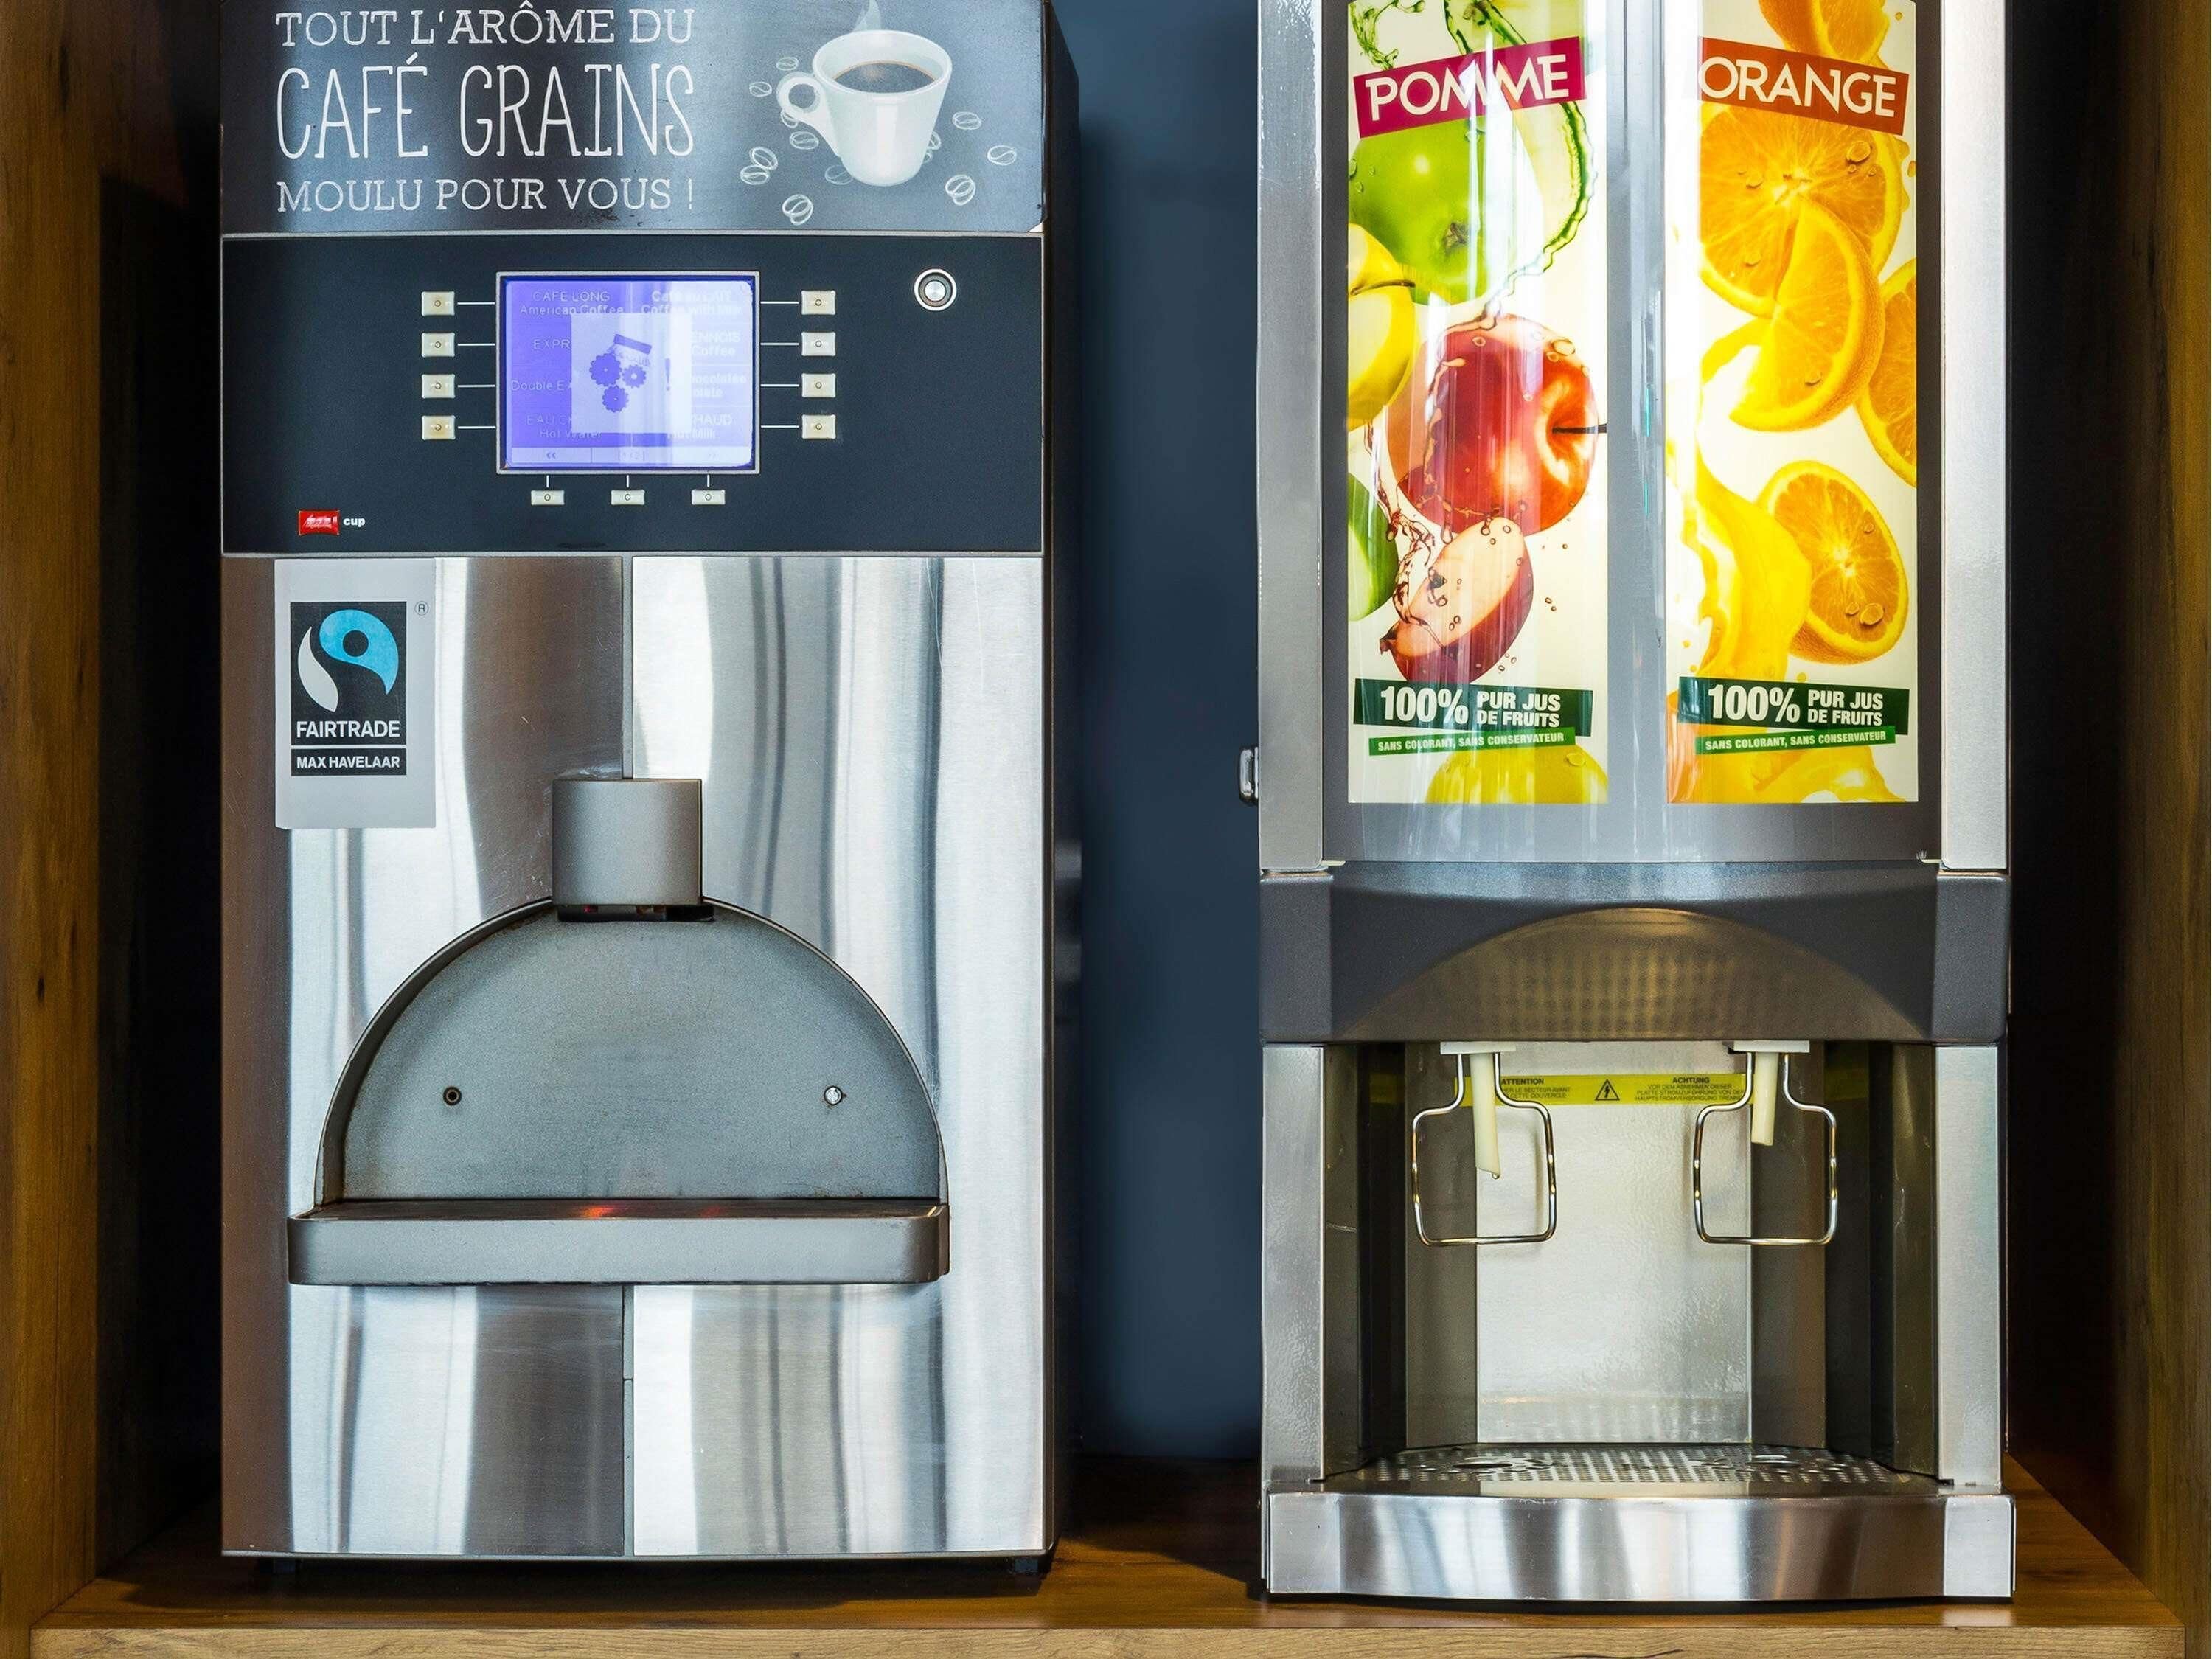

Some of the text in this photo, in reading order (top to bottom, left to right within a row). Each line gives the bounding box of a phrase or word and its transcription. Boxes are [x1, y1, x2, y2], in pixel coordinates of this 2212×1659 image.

[276, 0, 693, 46] TOUT L'ARÔME DU
[1365, 53, 1568, 122] POMME
[1699, 54, 1896, 118] ORANGE
[276, 52, 694, 159] CAFÉ GRAINS
[276, 179, 423, 212] MOULU
[435, 178, 546, 210] POUR
[558, 178, 670, 210] VOUS
[572, 291, 611, 302] LONG
[519, 305, 576, 315] American
[533, 339, 571, 349] EXPR
[343, 518, 366, 528] cup
[1380, 686, 1561, 725] 100% PUR JUS
[1708, 684, 1884, 723] 100% PUR JUS
[1477, 710, 1560, 728] DE FRUITS
[1808, 709, 1882, 726] DE FRUITS
[297, 721, 400, 737] FAIRTRADE
[1377, 732, 1564, 751] SANS COLORANT, SANS CONSERVATEUR
[1705, 731, 1886, 751] SANS COLORANT, SANS CONSERVATEUR
[296, 756, 400, 768] MAX HAVELAAR
